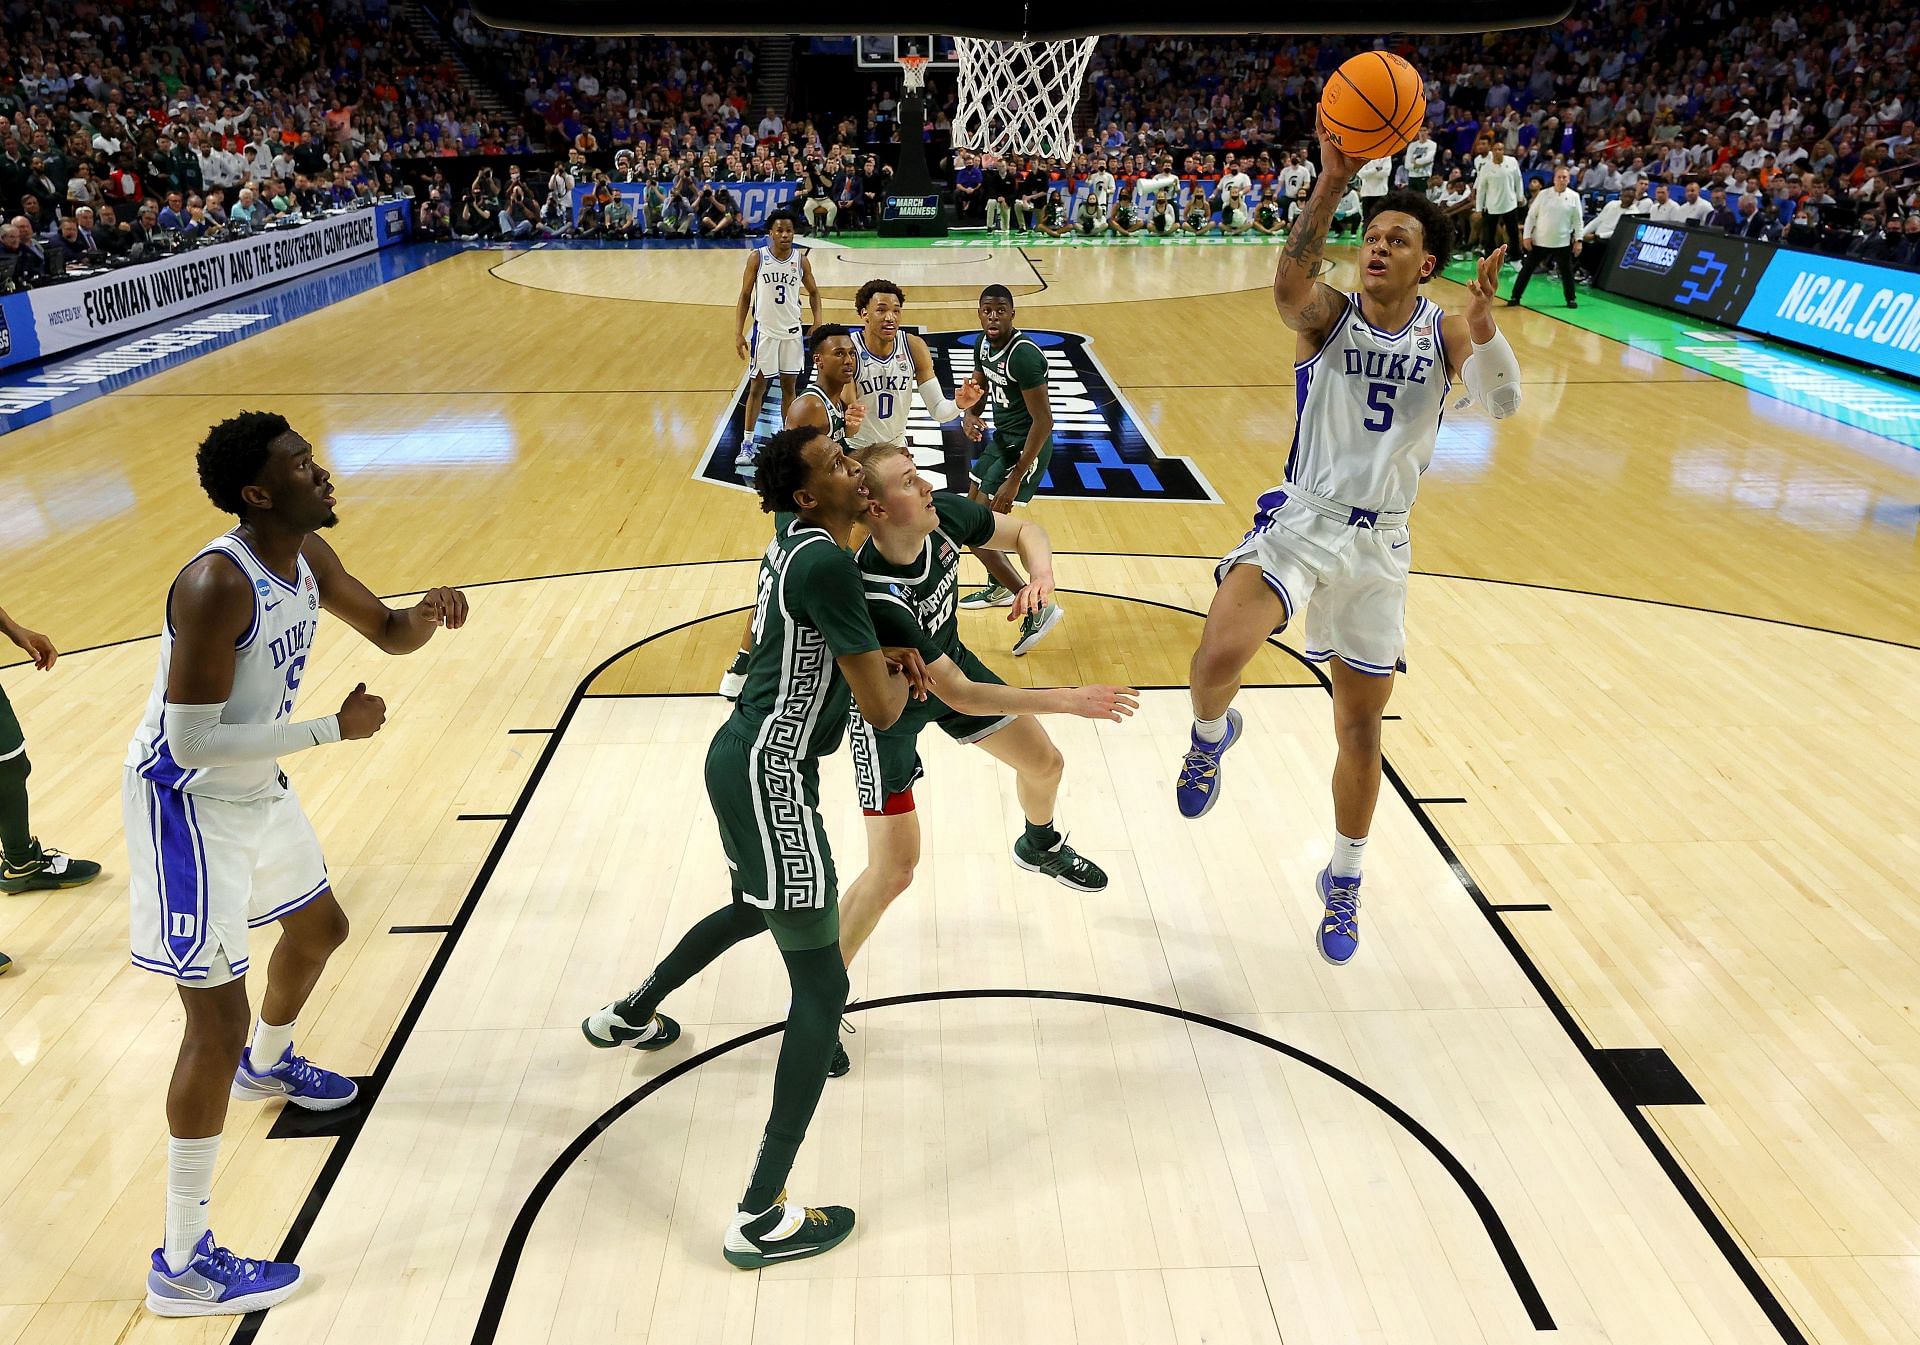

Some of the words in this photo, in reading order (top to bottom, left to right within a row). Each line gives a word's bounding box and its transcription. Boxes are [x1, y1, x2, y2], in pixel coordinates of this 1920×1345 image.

[896, 198, 924, 207] MARCH
[899, 207, 937, 216] MADNESS
[1641, 225, 1674, 247] MARCH
[1638, 243, 1678, 267] MADNESS
[83, 276, 151, 329] FURMAN
[150, 255, 226, 308] UNIVERSITY
[229, 249, 254, 285] AND
[253, 243, 274, 277] THE
[274, 230, 323, 270] SOUTHERN
[323, 216, 374, 255] CONFERENCE
[763, 272, 798, 287] DUKE
[775, 285, 786, 305] 3
[48, 308, 74, 327] HOSTED
[74, 306, 82, 320] BY
[1343, 348, 1434, 385] DUKE
[860, 375, 910, 396] DUKE
[878, 392, 894, 420] 0
[1363, 382, 1398, 433] 5
[171, 911, 195, 938] D
